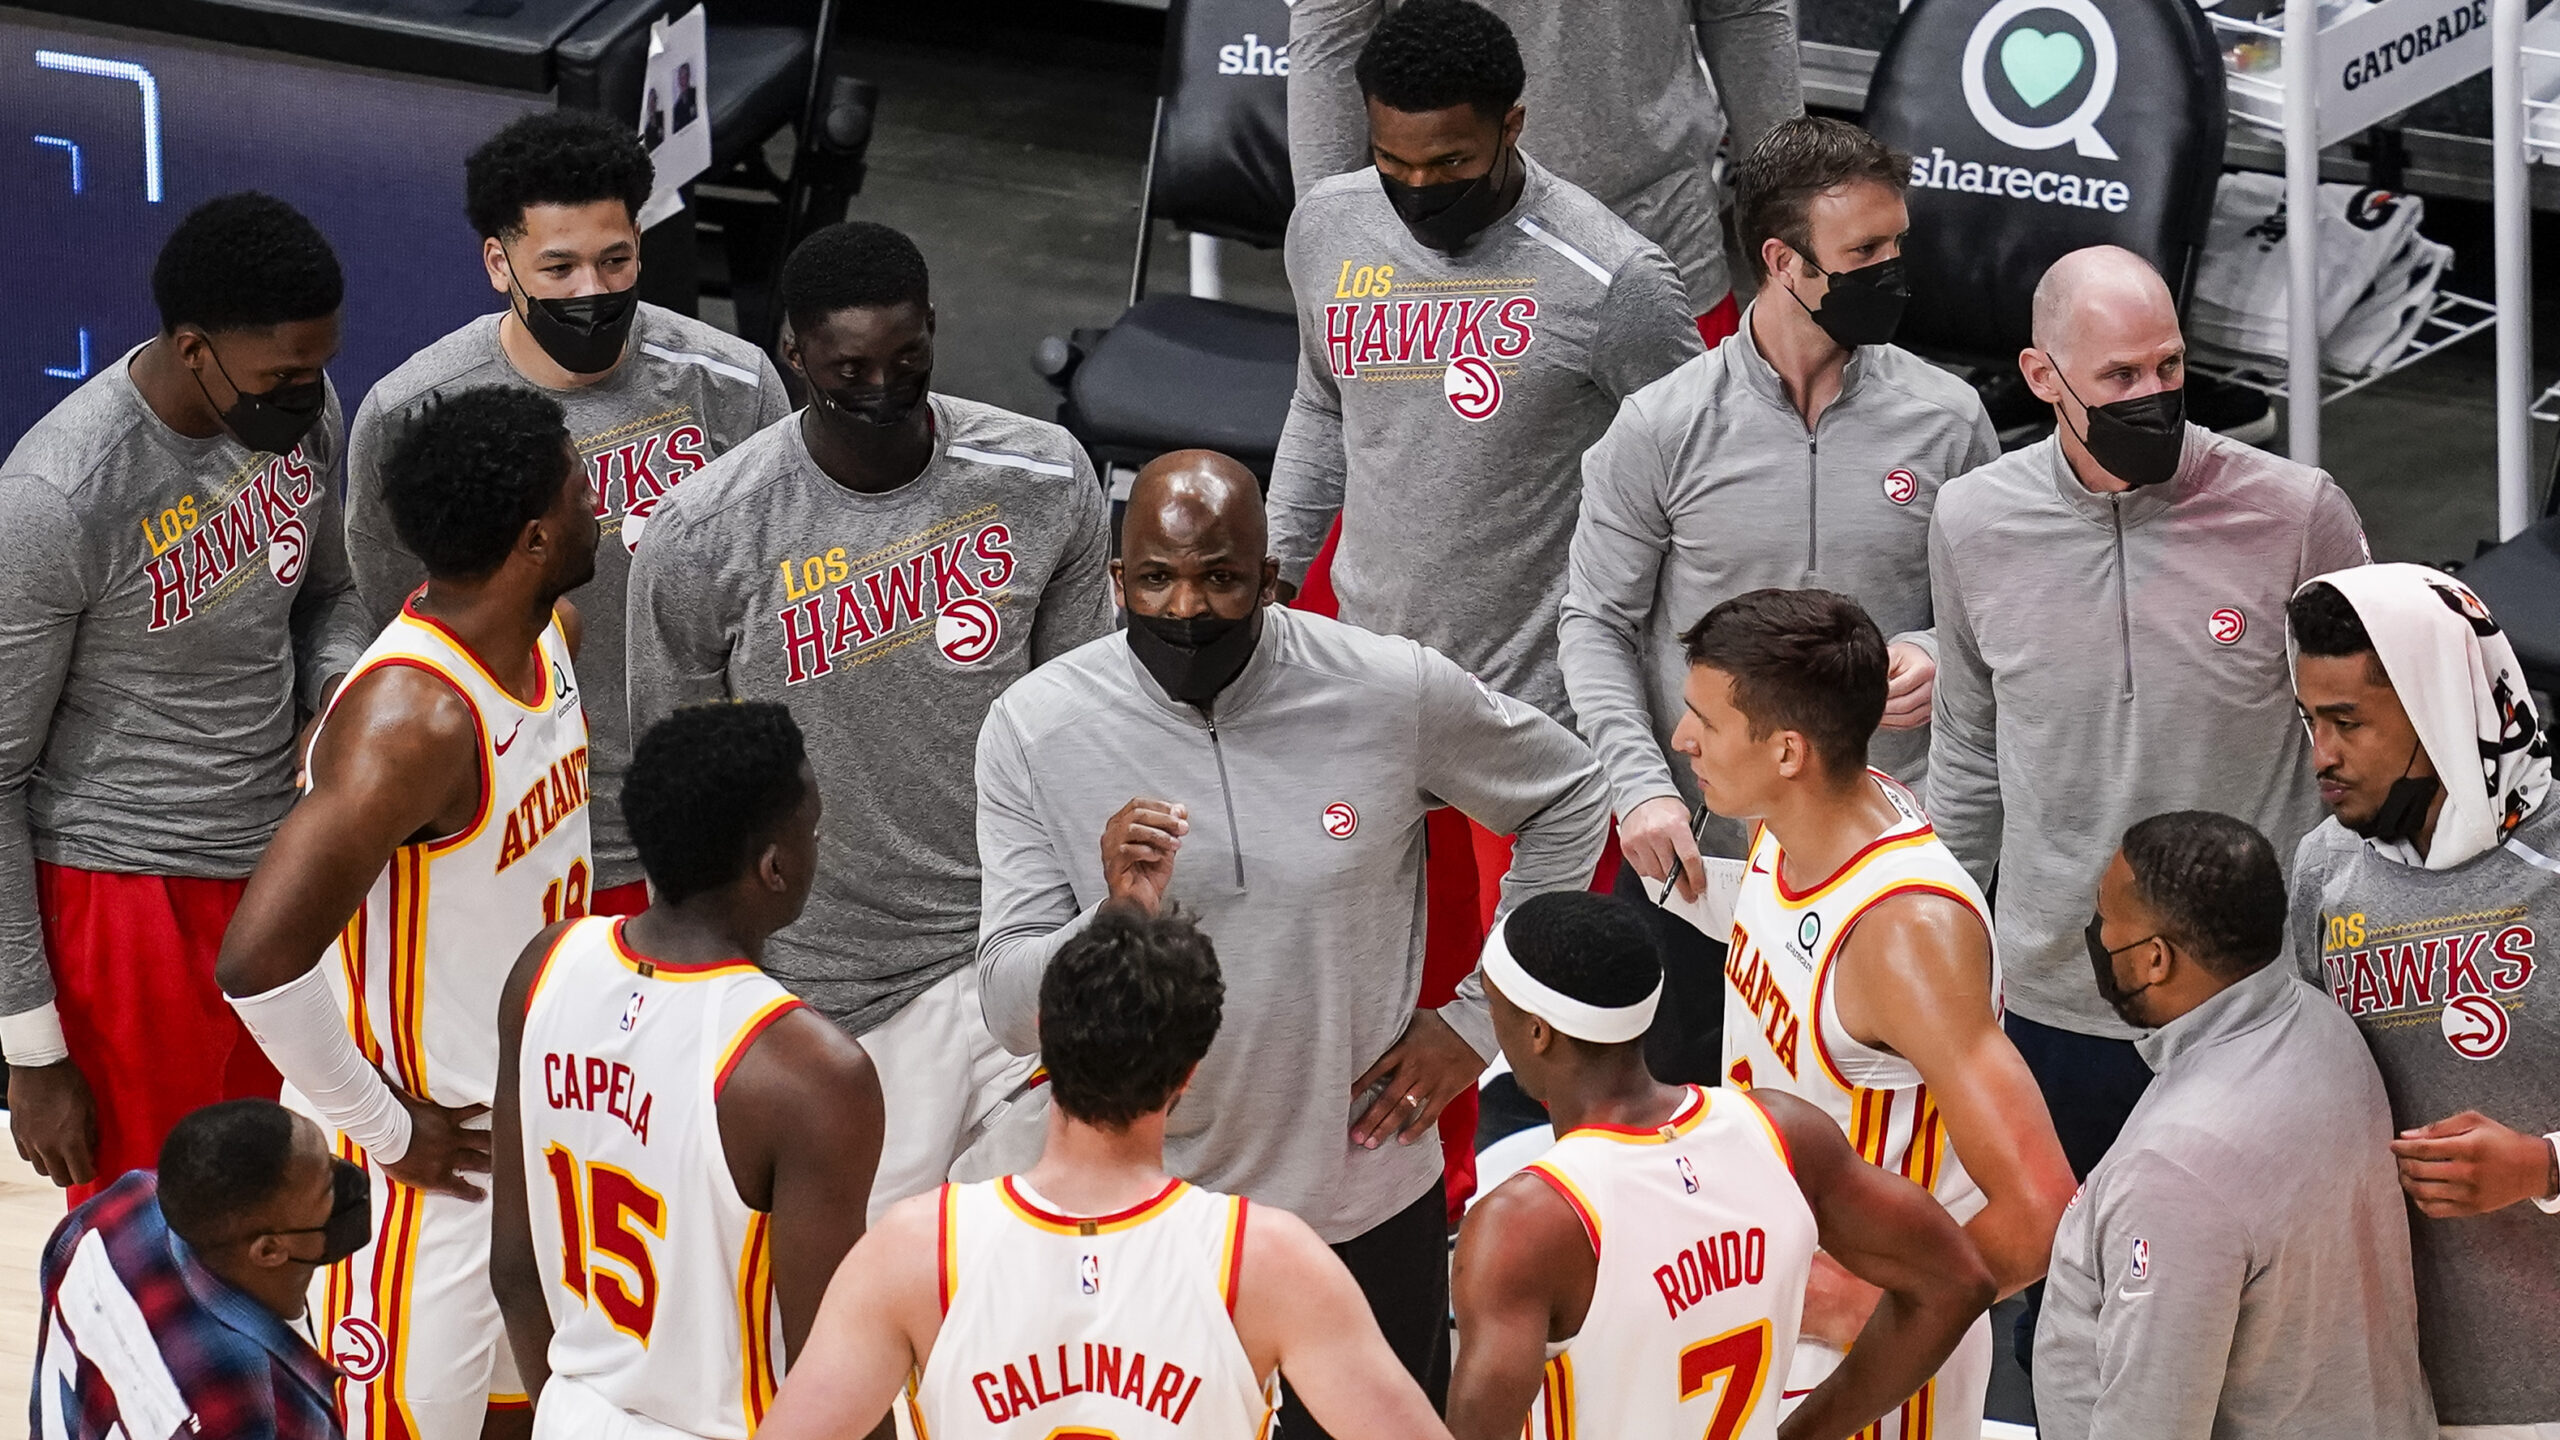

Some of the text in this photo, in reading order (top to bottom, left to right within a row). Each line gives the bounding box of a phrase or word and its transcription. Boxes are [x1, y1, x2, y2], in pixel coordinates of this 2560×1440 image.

[2343, 0, 2488, 91] GATORADE
[1909, 147, 2131, 213] sharecare
[1335, 260, 1394, 299] LOS
[1325, 295, 1539, 379] HAWKS
[141, 494, 199, 557] LOS
[143, 443, 314, 632] HAWKS
[778, 523, 1019, 686] HAWKS
[780, 547, 849, 601] LOS
[2324, 925, 2538, 1017] HAWKS
[544, 1053, 653, 1147] CAPELA
[542, 1139, 667, 1352] 15
[1653, 1227, 1766, 1321] RONDO
[972, 1342, 1202, 1425] GALLINARI
[1678, 1317, 1773, 1440] 7
